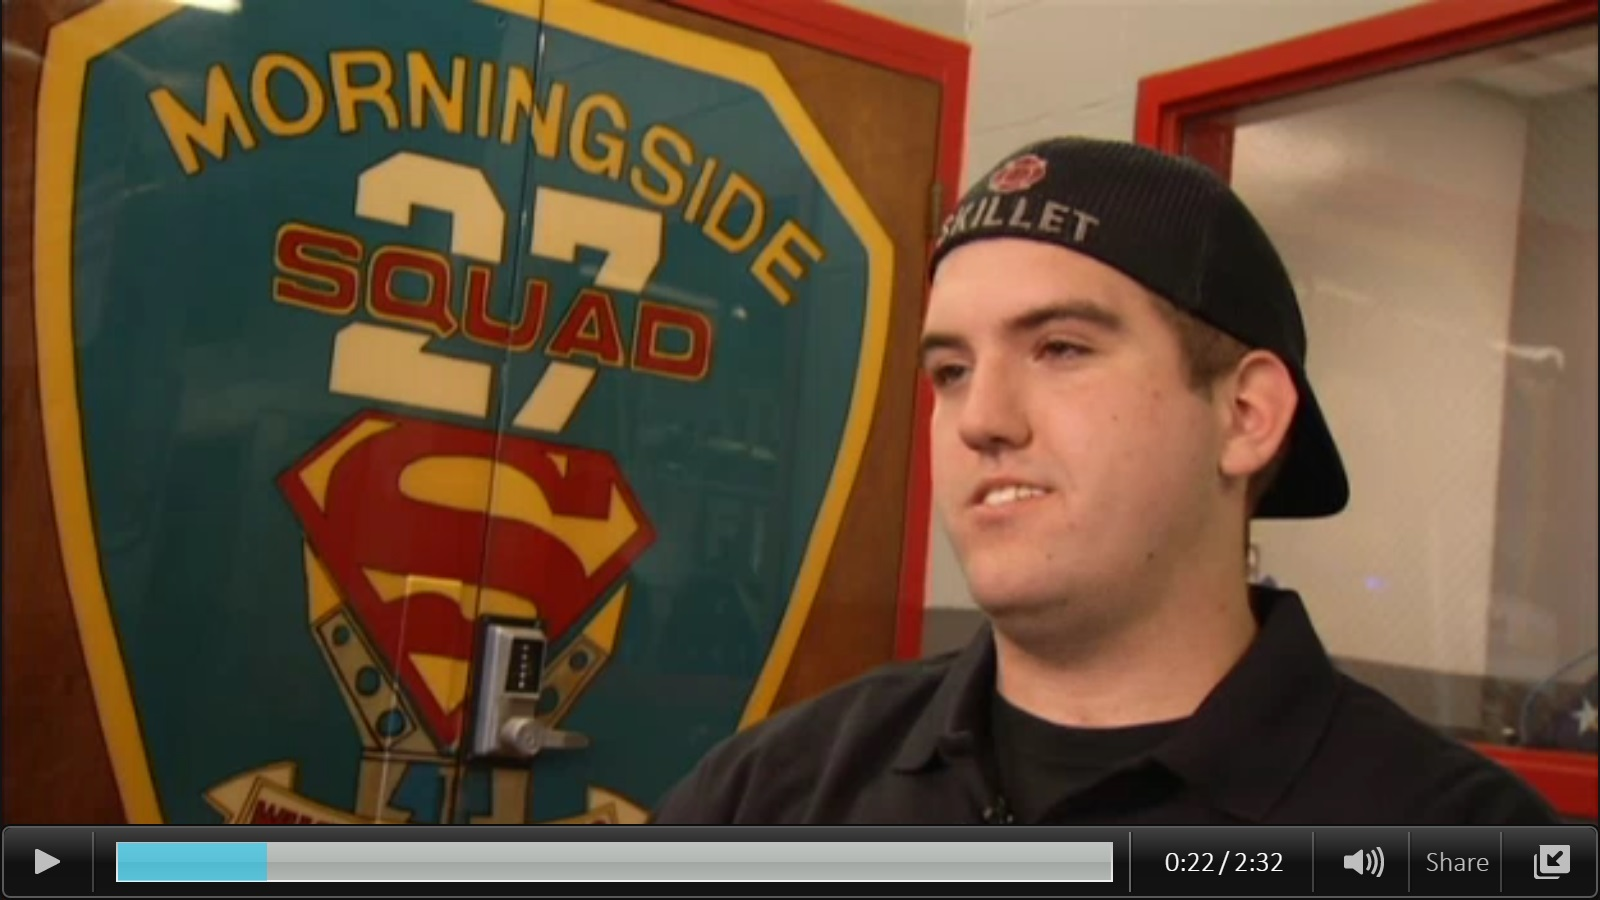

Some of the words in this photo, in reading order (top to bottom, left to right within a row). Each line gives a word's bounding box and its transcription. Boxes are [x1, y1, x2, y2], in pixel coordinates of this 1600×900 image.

[149, 49, 824, 306] MORNINGSIDE
[273, 223, 713, 381] SQUAD
[329, 151, 664, 433] 27
